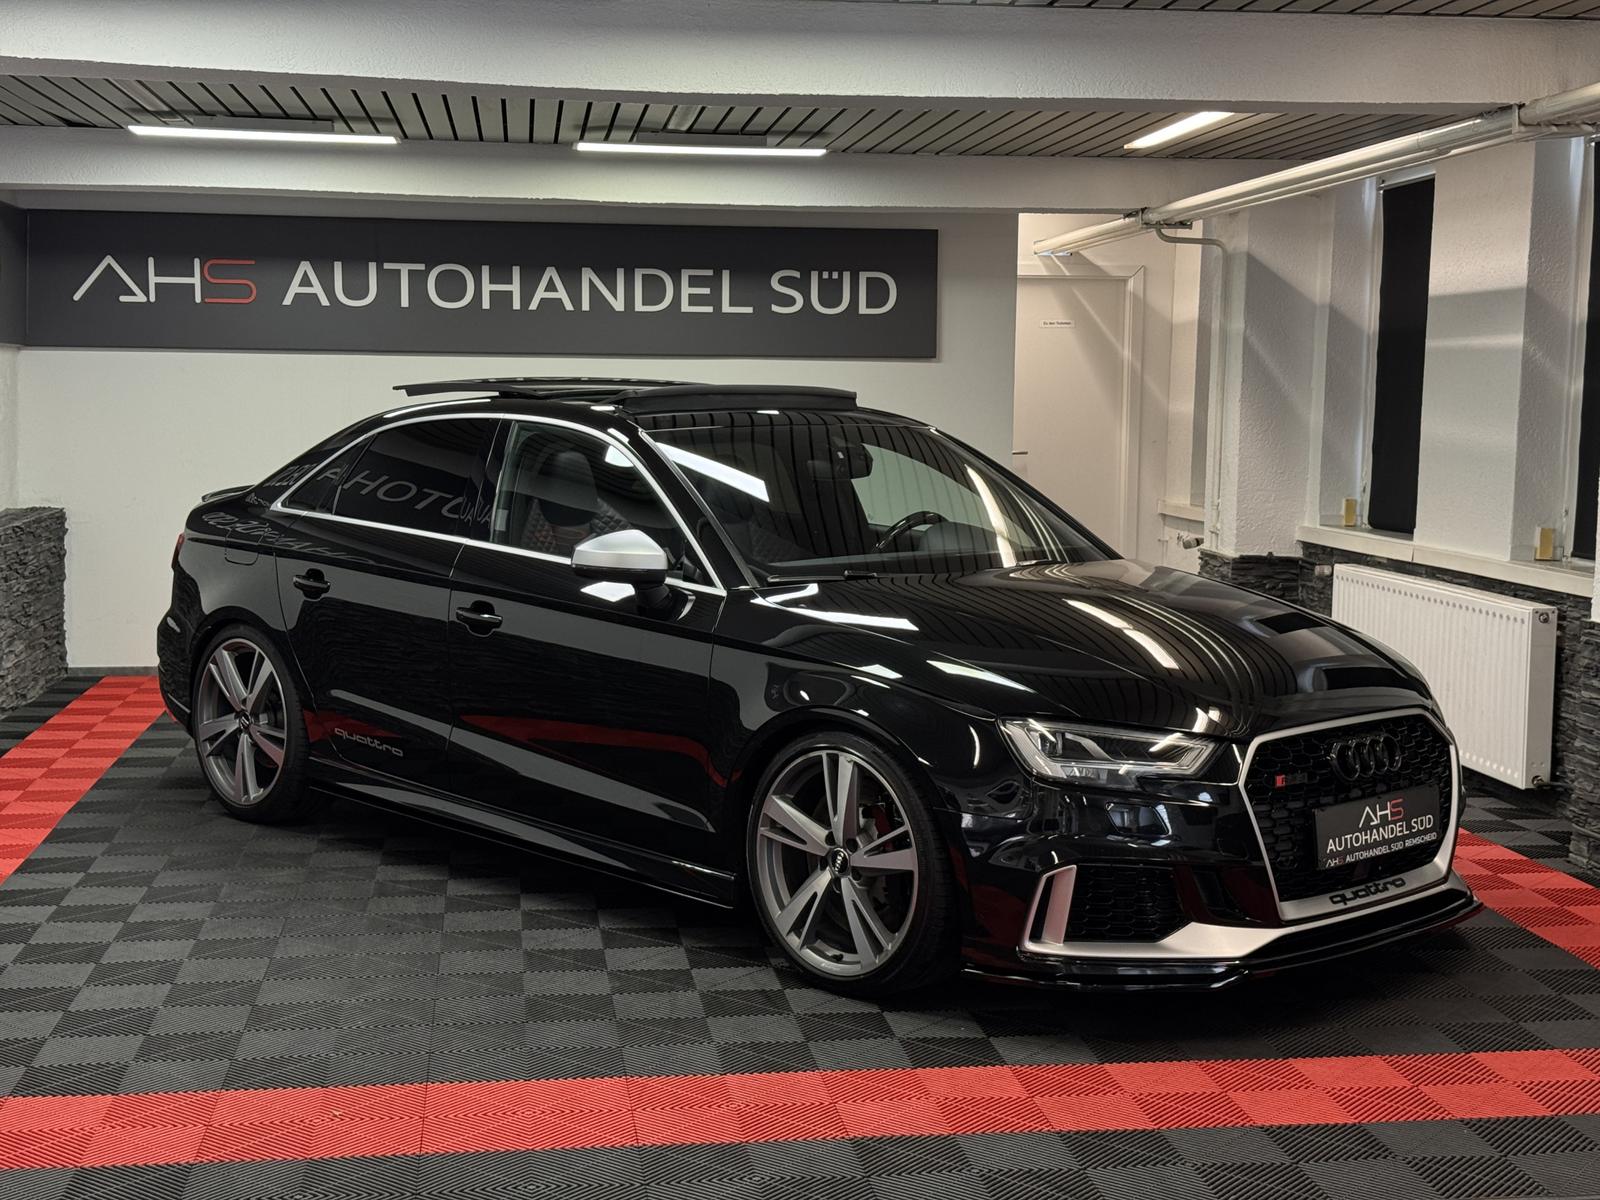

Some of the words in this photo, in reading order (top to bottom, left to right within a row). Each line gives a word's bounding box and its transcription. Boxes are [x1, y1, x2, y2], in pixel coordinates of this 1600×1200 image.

[72, 254, 257, 305] AHS
[281, 260, 754, 314] AUTOHANDEL
[770, 269, 898, 316] SÜD
[334, 727, 404, 757] quattro
[1358, 798, 1405, 829] AHS
[1325, 855, 1345, 868] AHS
[1345, 846, 1391, 864] AUTOHANDEL
[1390, 841, 1404, 853] SÜD
[1404, 831, 1438, 848] REMSCHEID
[1326, 821, 1410, 854] AUTOHANDEL
[1410, 814, 1435, 833] SÜD
[1328, 877, 1407, 906] quattro
